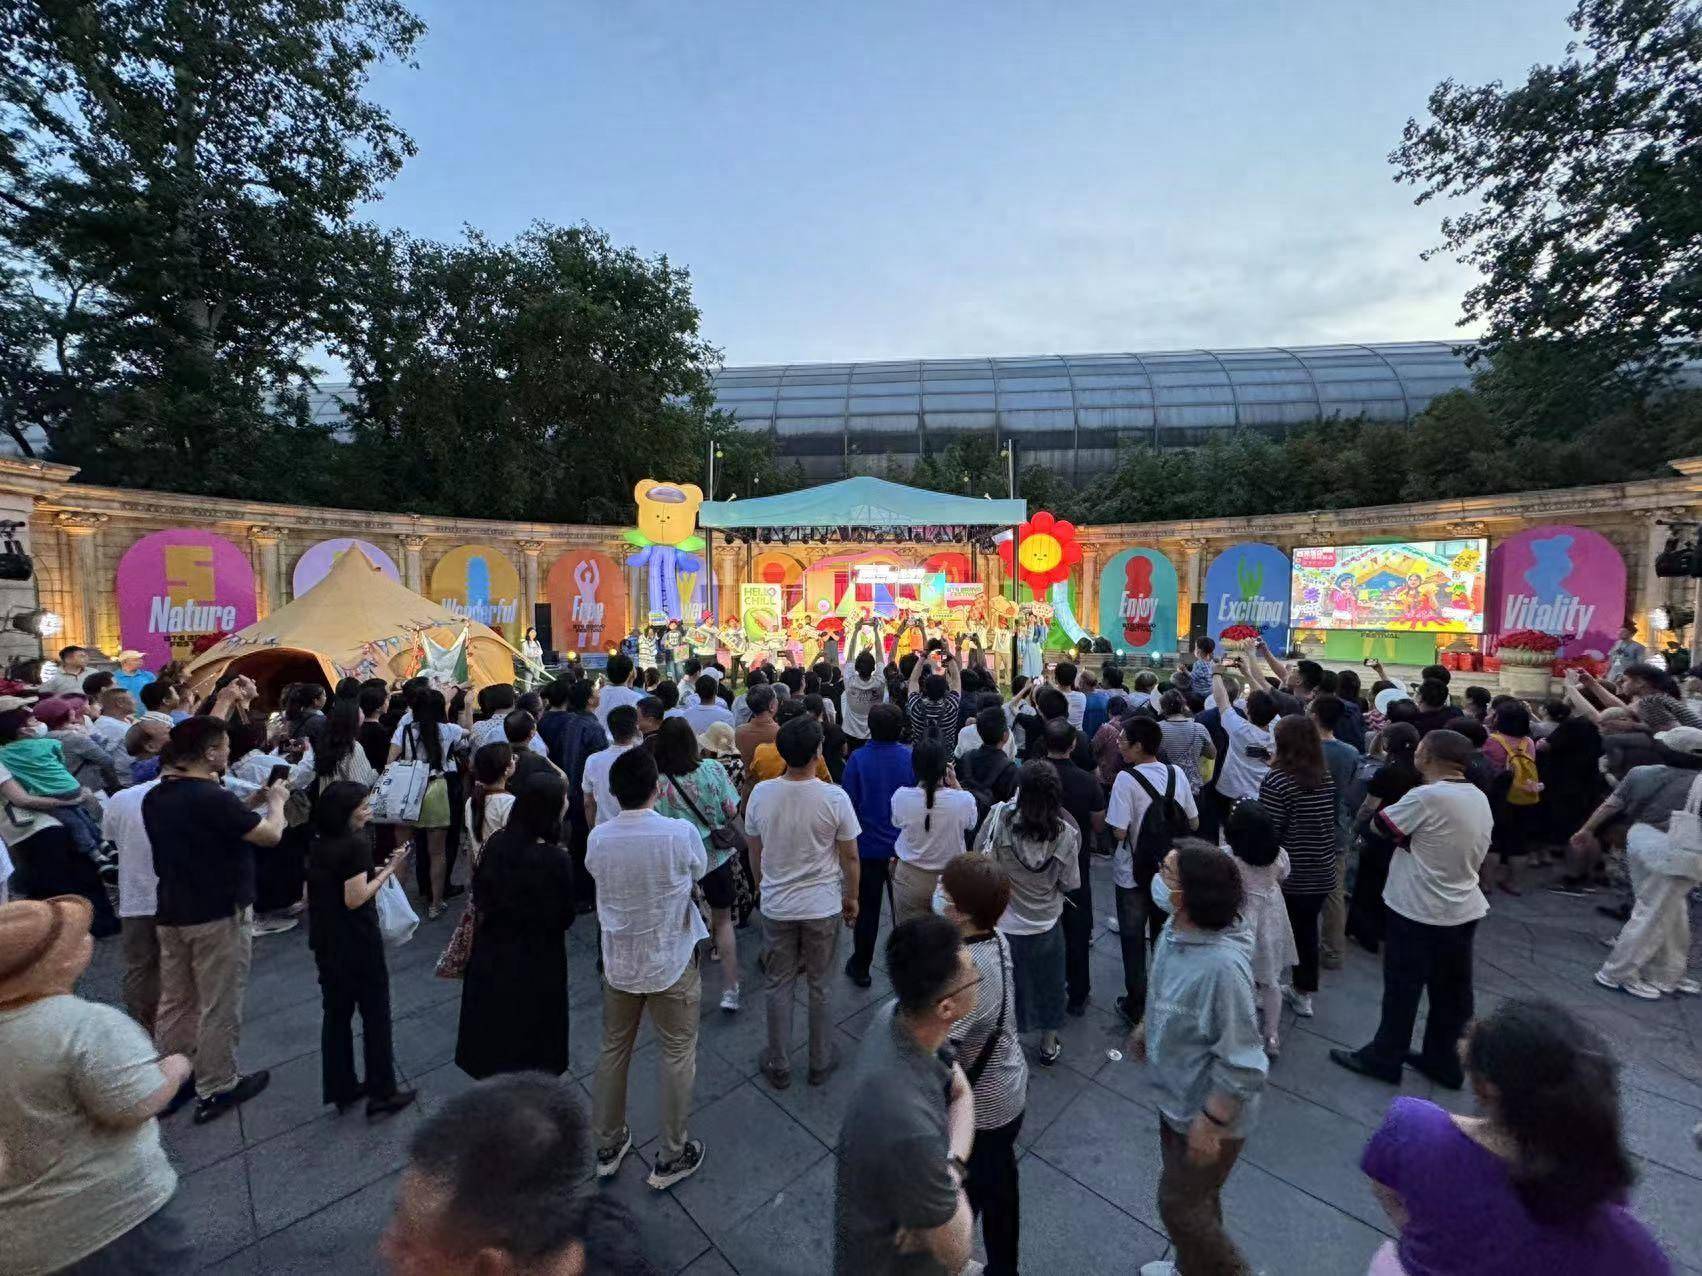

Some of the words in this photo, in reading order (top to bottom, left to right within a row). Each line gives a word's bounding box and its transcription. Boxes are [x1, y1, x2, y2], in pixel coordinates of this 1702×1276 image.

[148, 596, 236, 634] Nature
[441, 598, 518, 624] Wonderful
[572, 595, 604, 622] Free
[744, 597, 777, 606] CHILL
[1119, 591, 1159, 623] Enjoy
[1218, 594, 1283, 628] Exciting
[1504, 594, 1596, 640] Vitality
[1361, 631, 1399, 639] FESTIVAL
